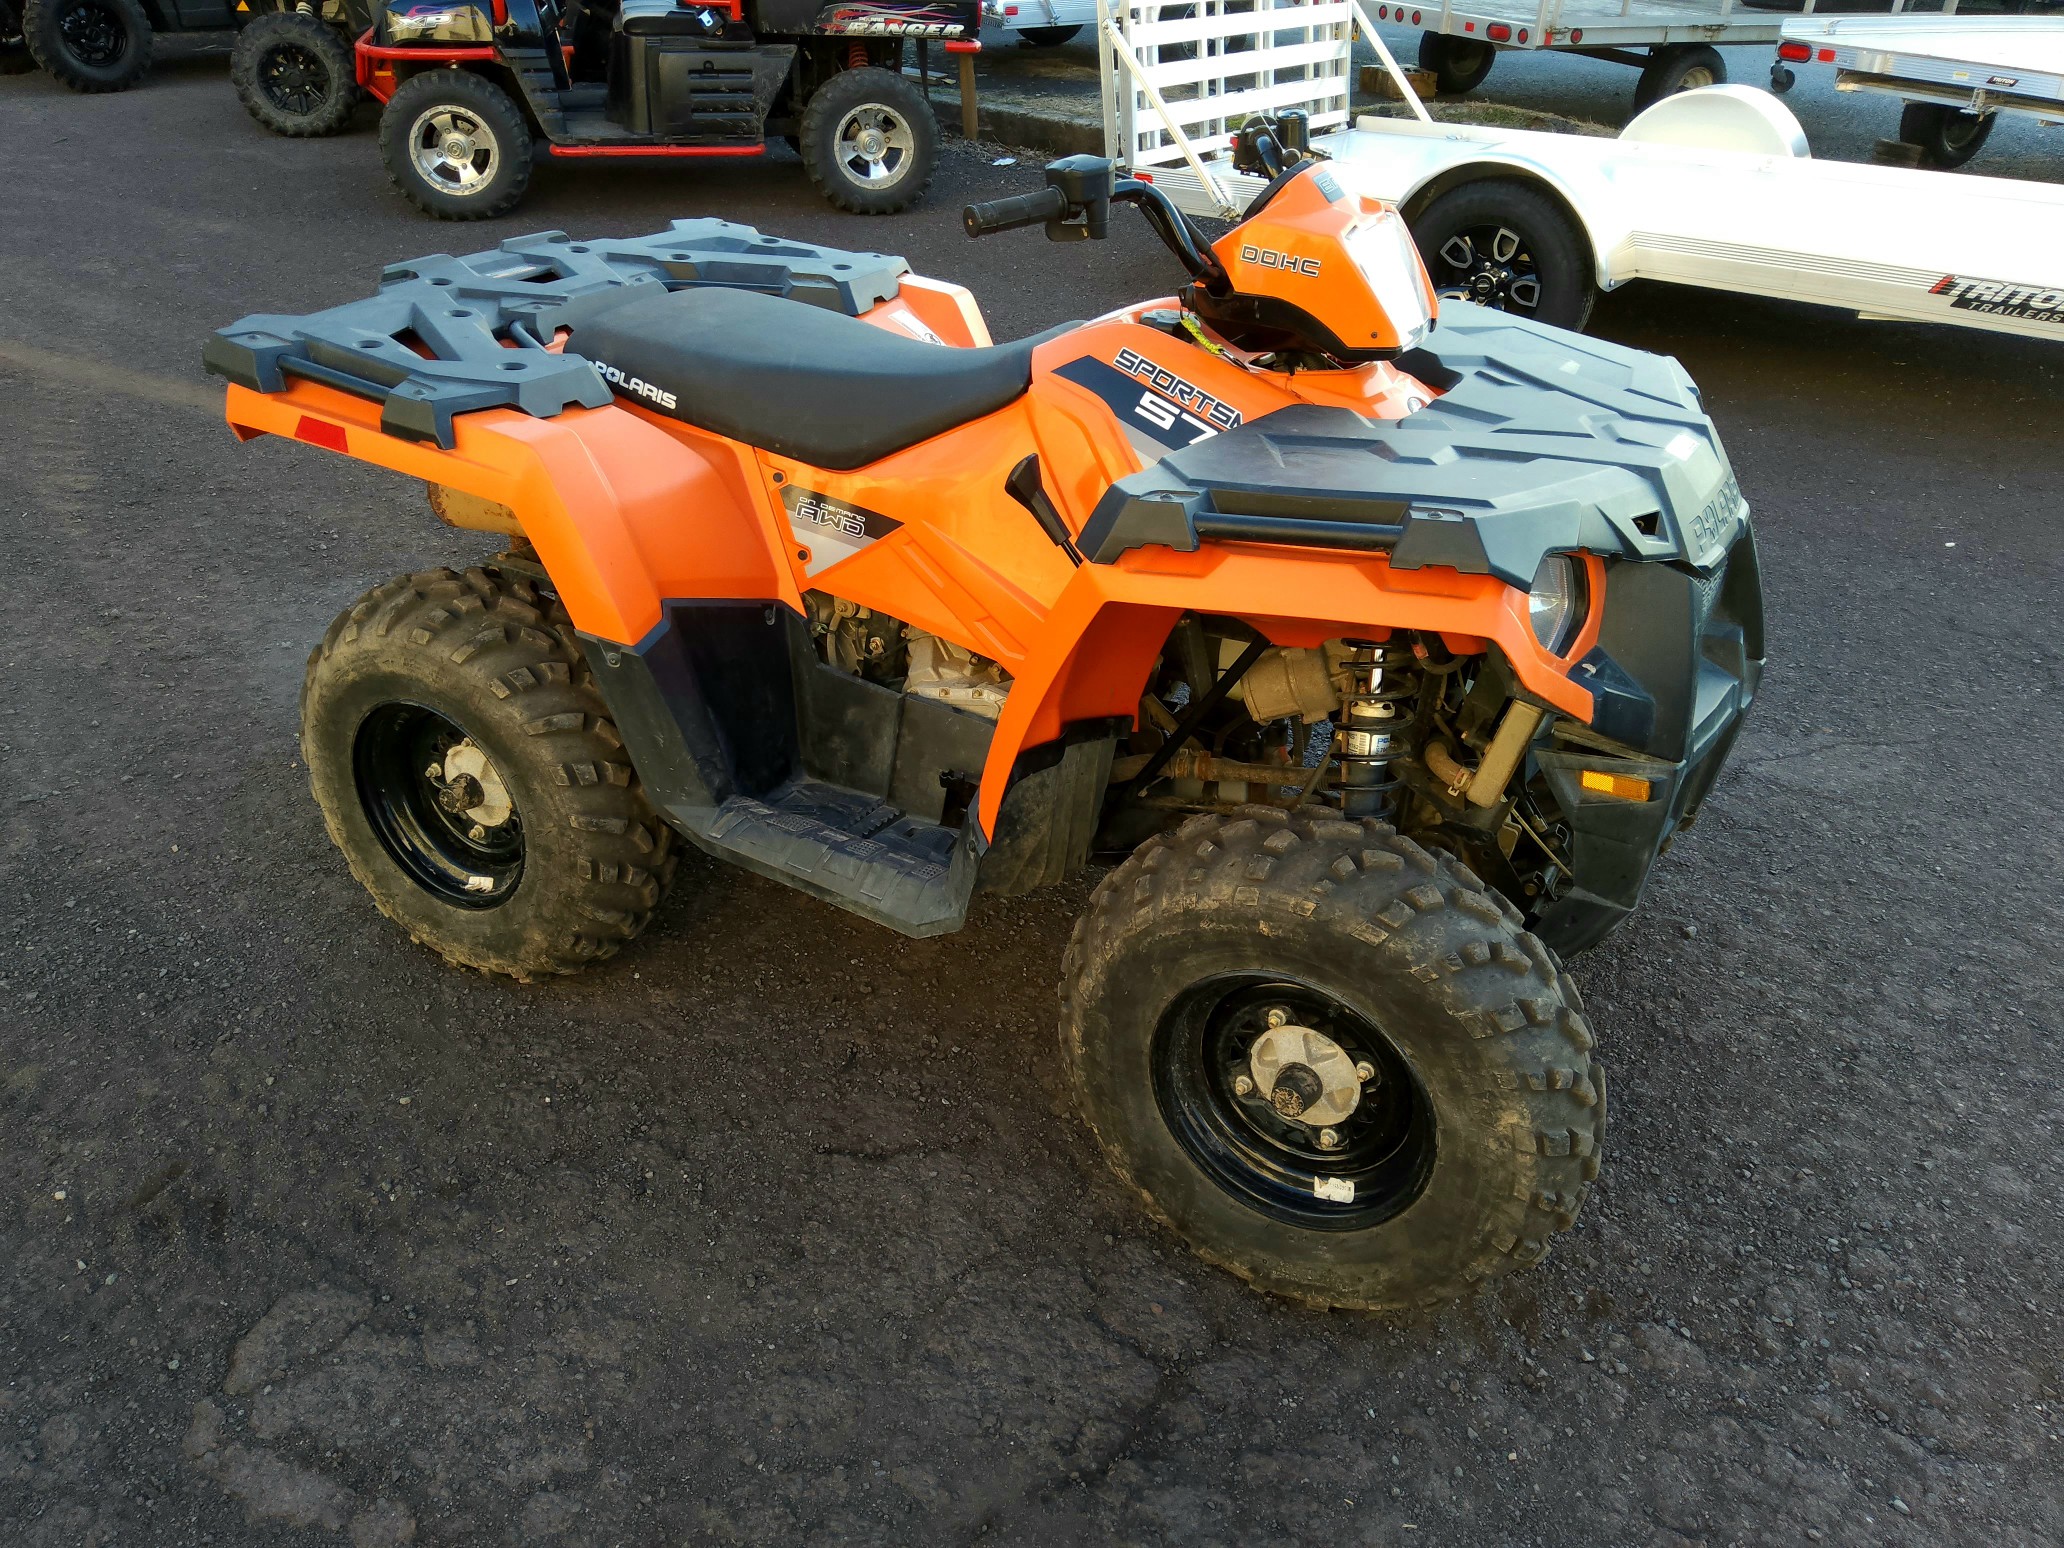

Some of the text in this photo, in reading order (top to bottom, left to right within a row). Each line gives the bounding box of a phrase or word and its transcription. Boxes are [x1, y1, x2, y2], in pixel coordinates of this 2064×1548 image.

[387, 13, 452, 32] XP
[844, 22, 966, 37] RANGER
[1240, 244, 1321, 278] DOHC
[1966, 301, 2064, 323] TRAILERS
[594, 360, 678, 410] POLARIS
[795, 502, 865, 538] AWD
